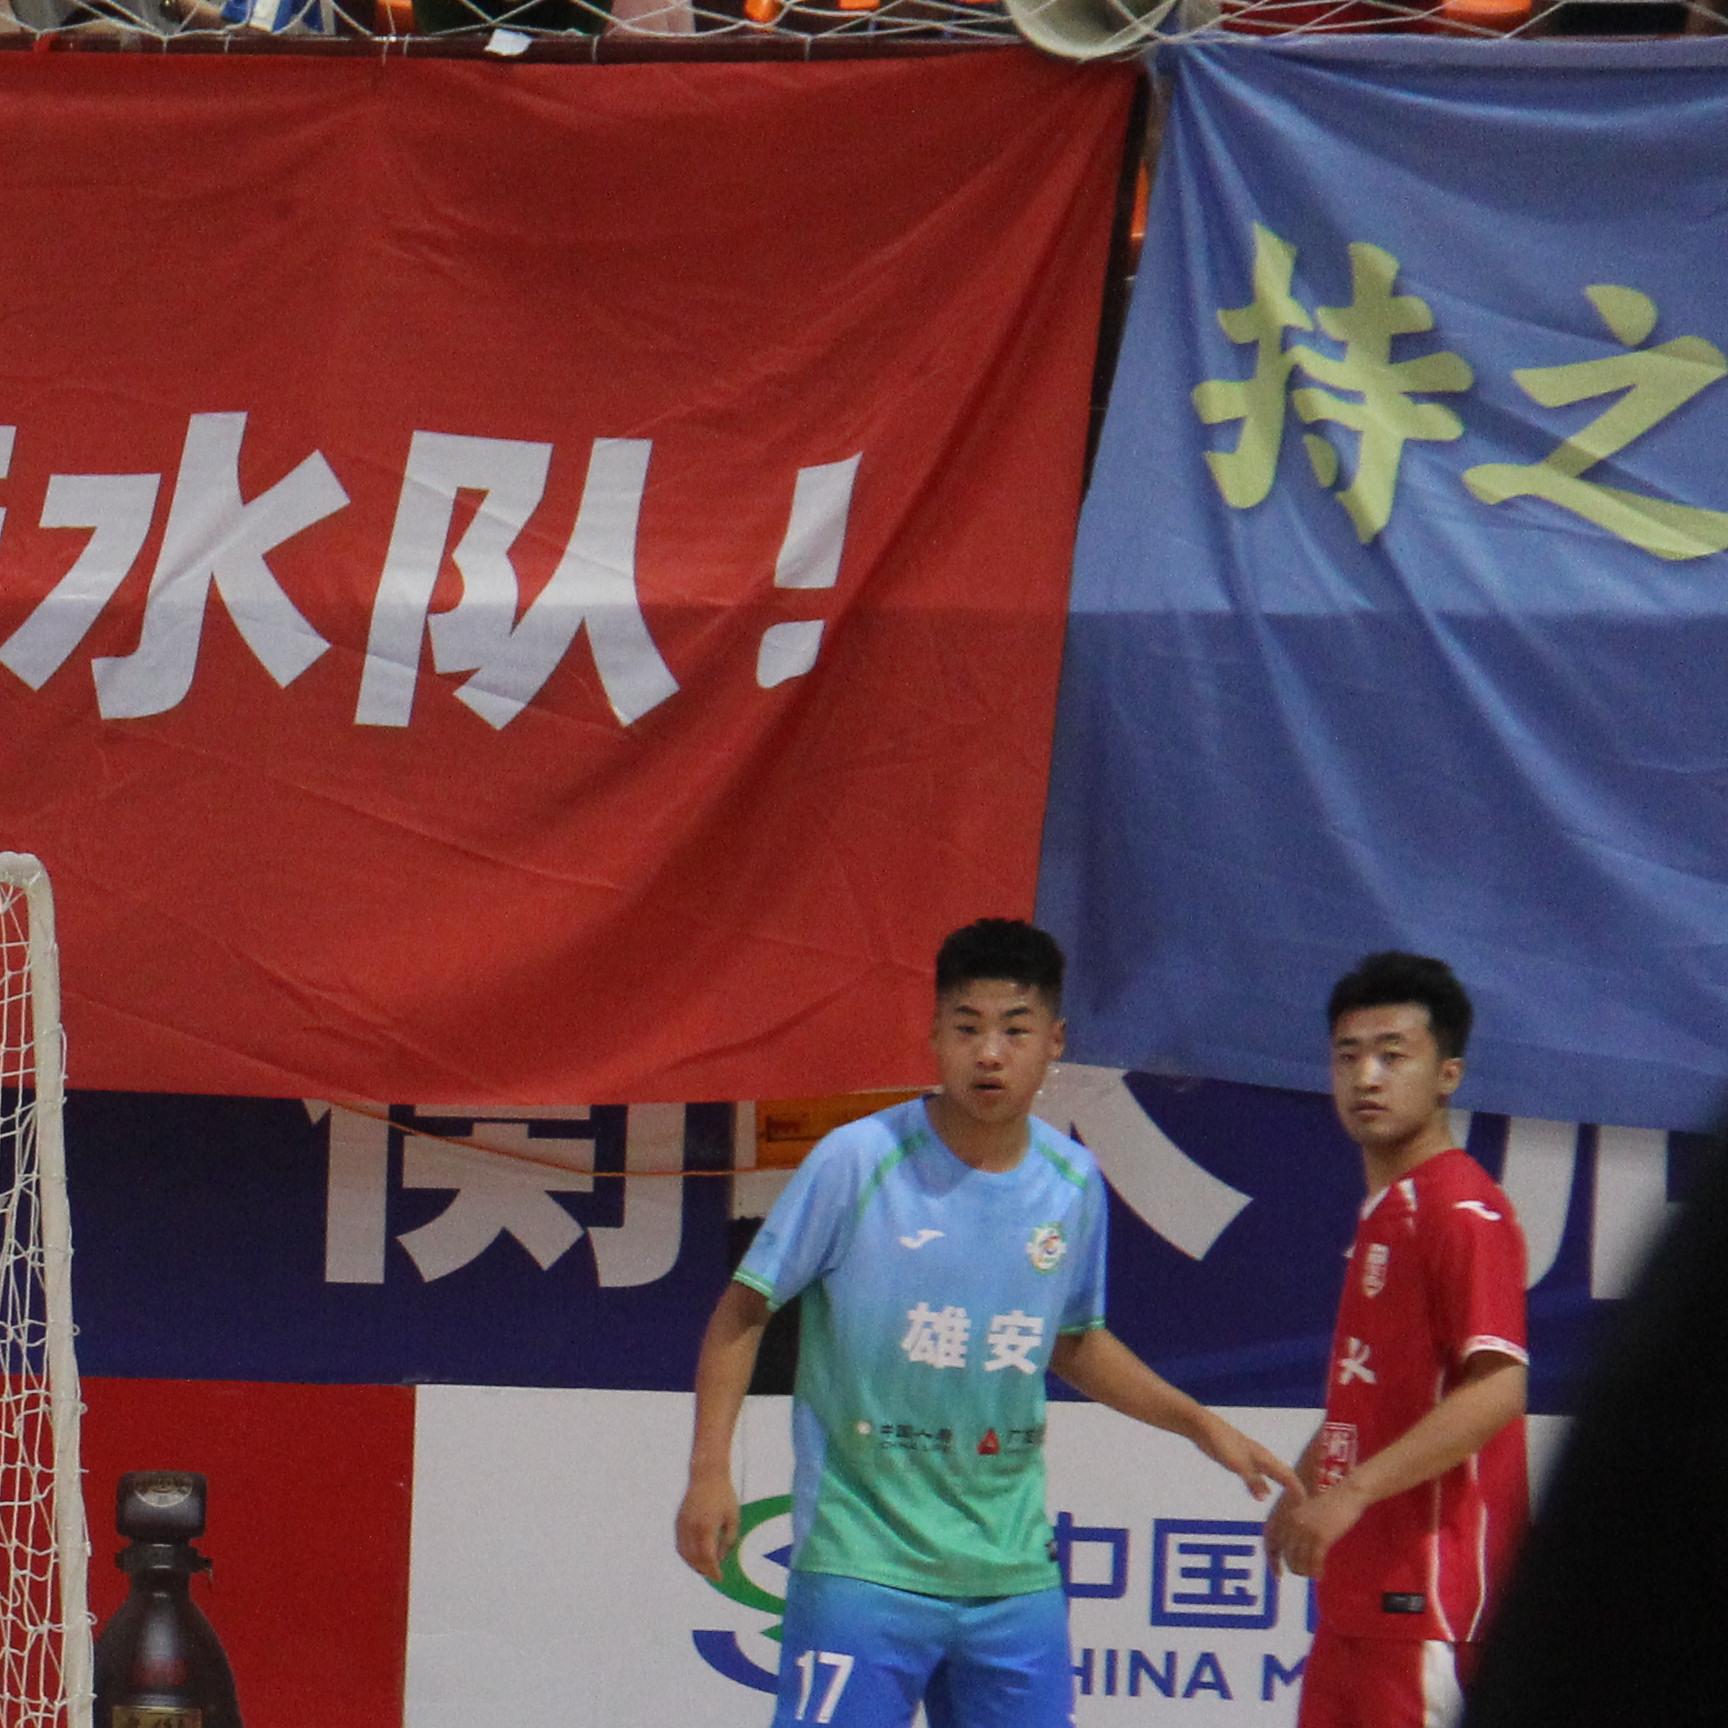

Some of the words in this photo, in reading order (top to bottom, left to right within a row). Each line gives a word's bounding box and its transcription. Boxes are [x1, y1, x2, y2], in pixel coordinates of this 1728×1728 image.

[1191, 220, 1728, 560] 持之
[900, 1302, 1044, 1375] 雄安
[1054, 1511, 1320, 1632] 中国
[795, 1650, 855, 1724] 17
[1072, 1647, 1234, 1701] HINA
